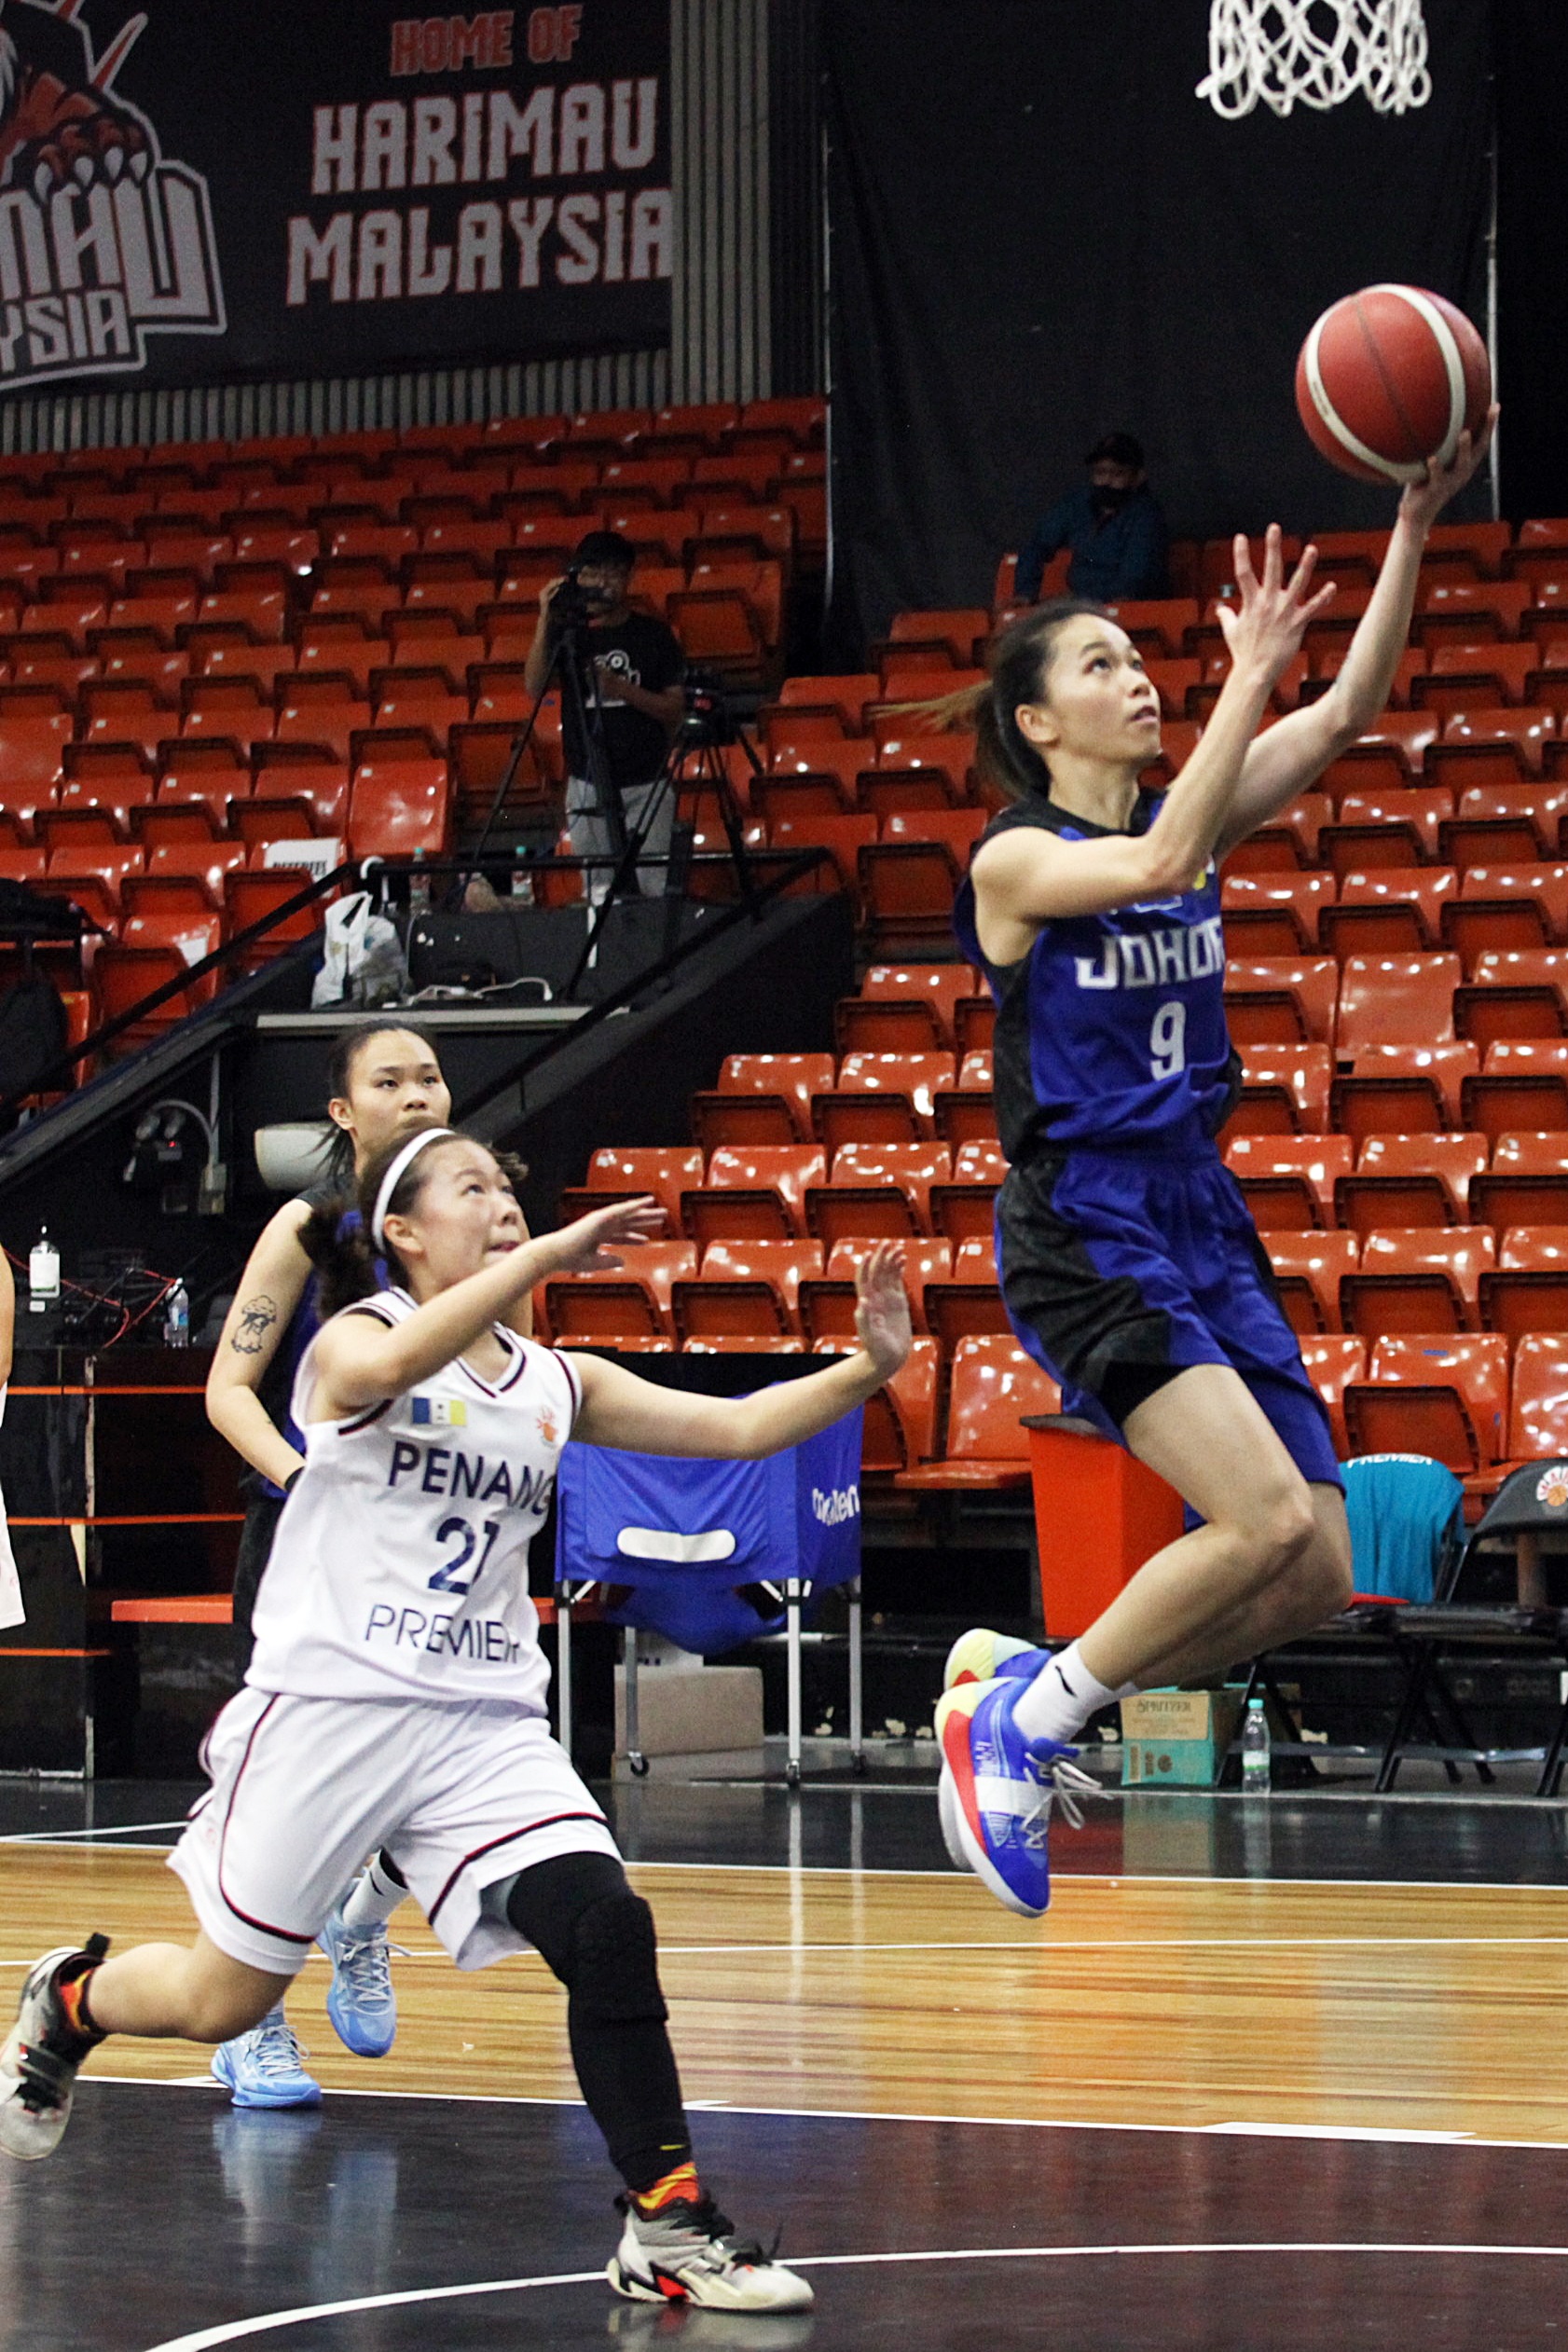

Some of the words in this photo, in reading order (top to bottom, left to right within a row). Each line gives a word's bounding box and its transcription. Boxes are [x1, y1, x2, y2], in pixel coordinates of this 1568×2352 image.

[390, 11, 515, 76] HOME
[528, 5, 583, 63] OF
[311, 78, 658, 195] HARIMAU
[285, 188, 671, 305] MALAYSIA
[1150, 1001, 1186, 1081] 9
[428, 1517, 500, 1595] 21
